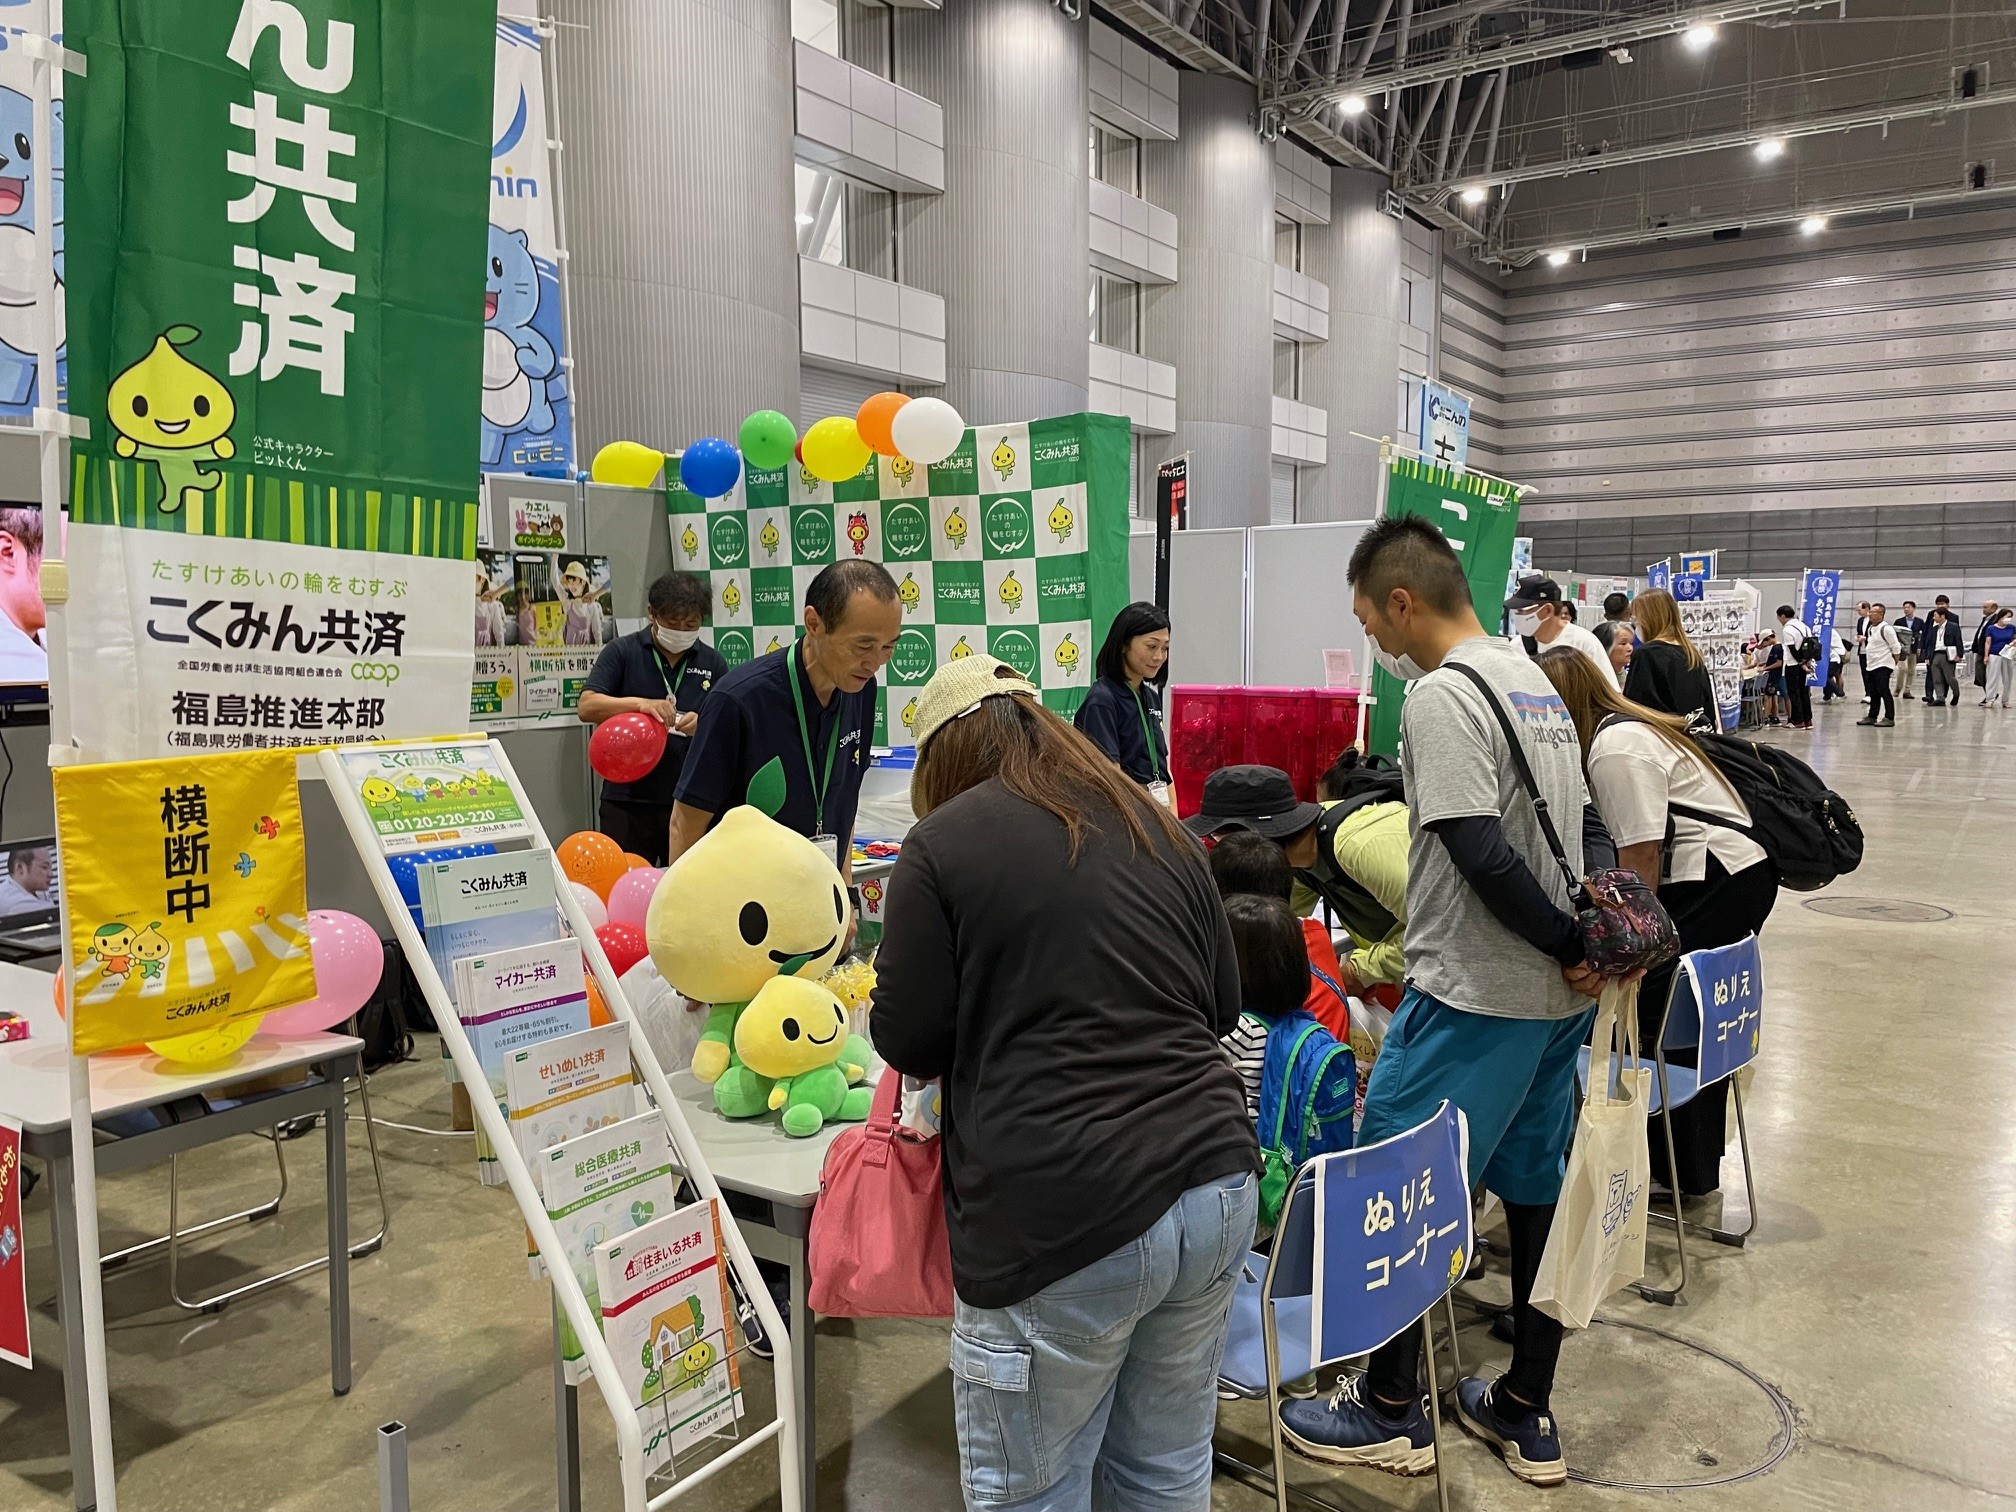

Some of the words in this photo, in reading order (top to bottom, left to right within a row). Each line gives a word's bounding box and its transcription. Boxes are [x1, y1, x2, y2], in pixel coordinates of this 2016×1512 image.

[226, 0, 357, 397] ん共済
[253, 435, 334, 458] 公式キャラクター
[254, 450, 307, 471] ピットくん
[1034, 444, 1079, 461] こくみん共済
[931, 457, 973, 470] こくみん共済
[152, 559, 408, 598] たすけあいの輪をむすぶ
[1041, 582, 1086, 597] こくみん共済
[937, 588, 980, 600] こくみん共済
[146, 596, 406, 657] こくみん共済
[177, 659, 343, 678] 全国労働者共済生活協同組合連合会
[172, 690, 386, 730] 福島推進本部
[393, 810, 496, 832] 0120-220-220
[160, 783, 211, 924] 横断中
[460, 871, 527, 894] こくみん共済
[494, 965, 556, 989] マイカー共済
[1714, 970, 1751, 1007] ぬりえ
[166, 992, 231, 1020] こくみん共済
[1717, 1006, 1759, 1042] コーナー
[539, 1048, 605, 1080] せいめい共済
[574, 1140, 641, 1178] 総合医療共済
[1364, 1167, 1435, 1236] ぬりえ
[1366, 1219, 1459, 1291] コーナー
